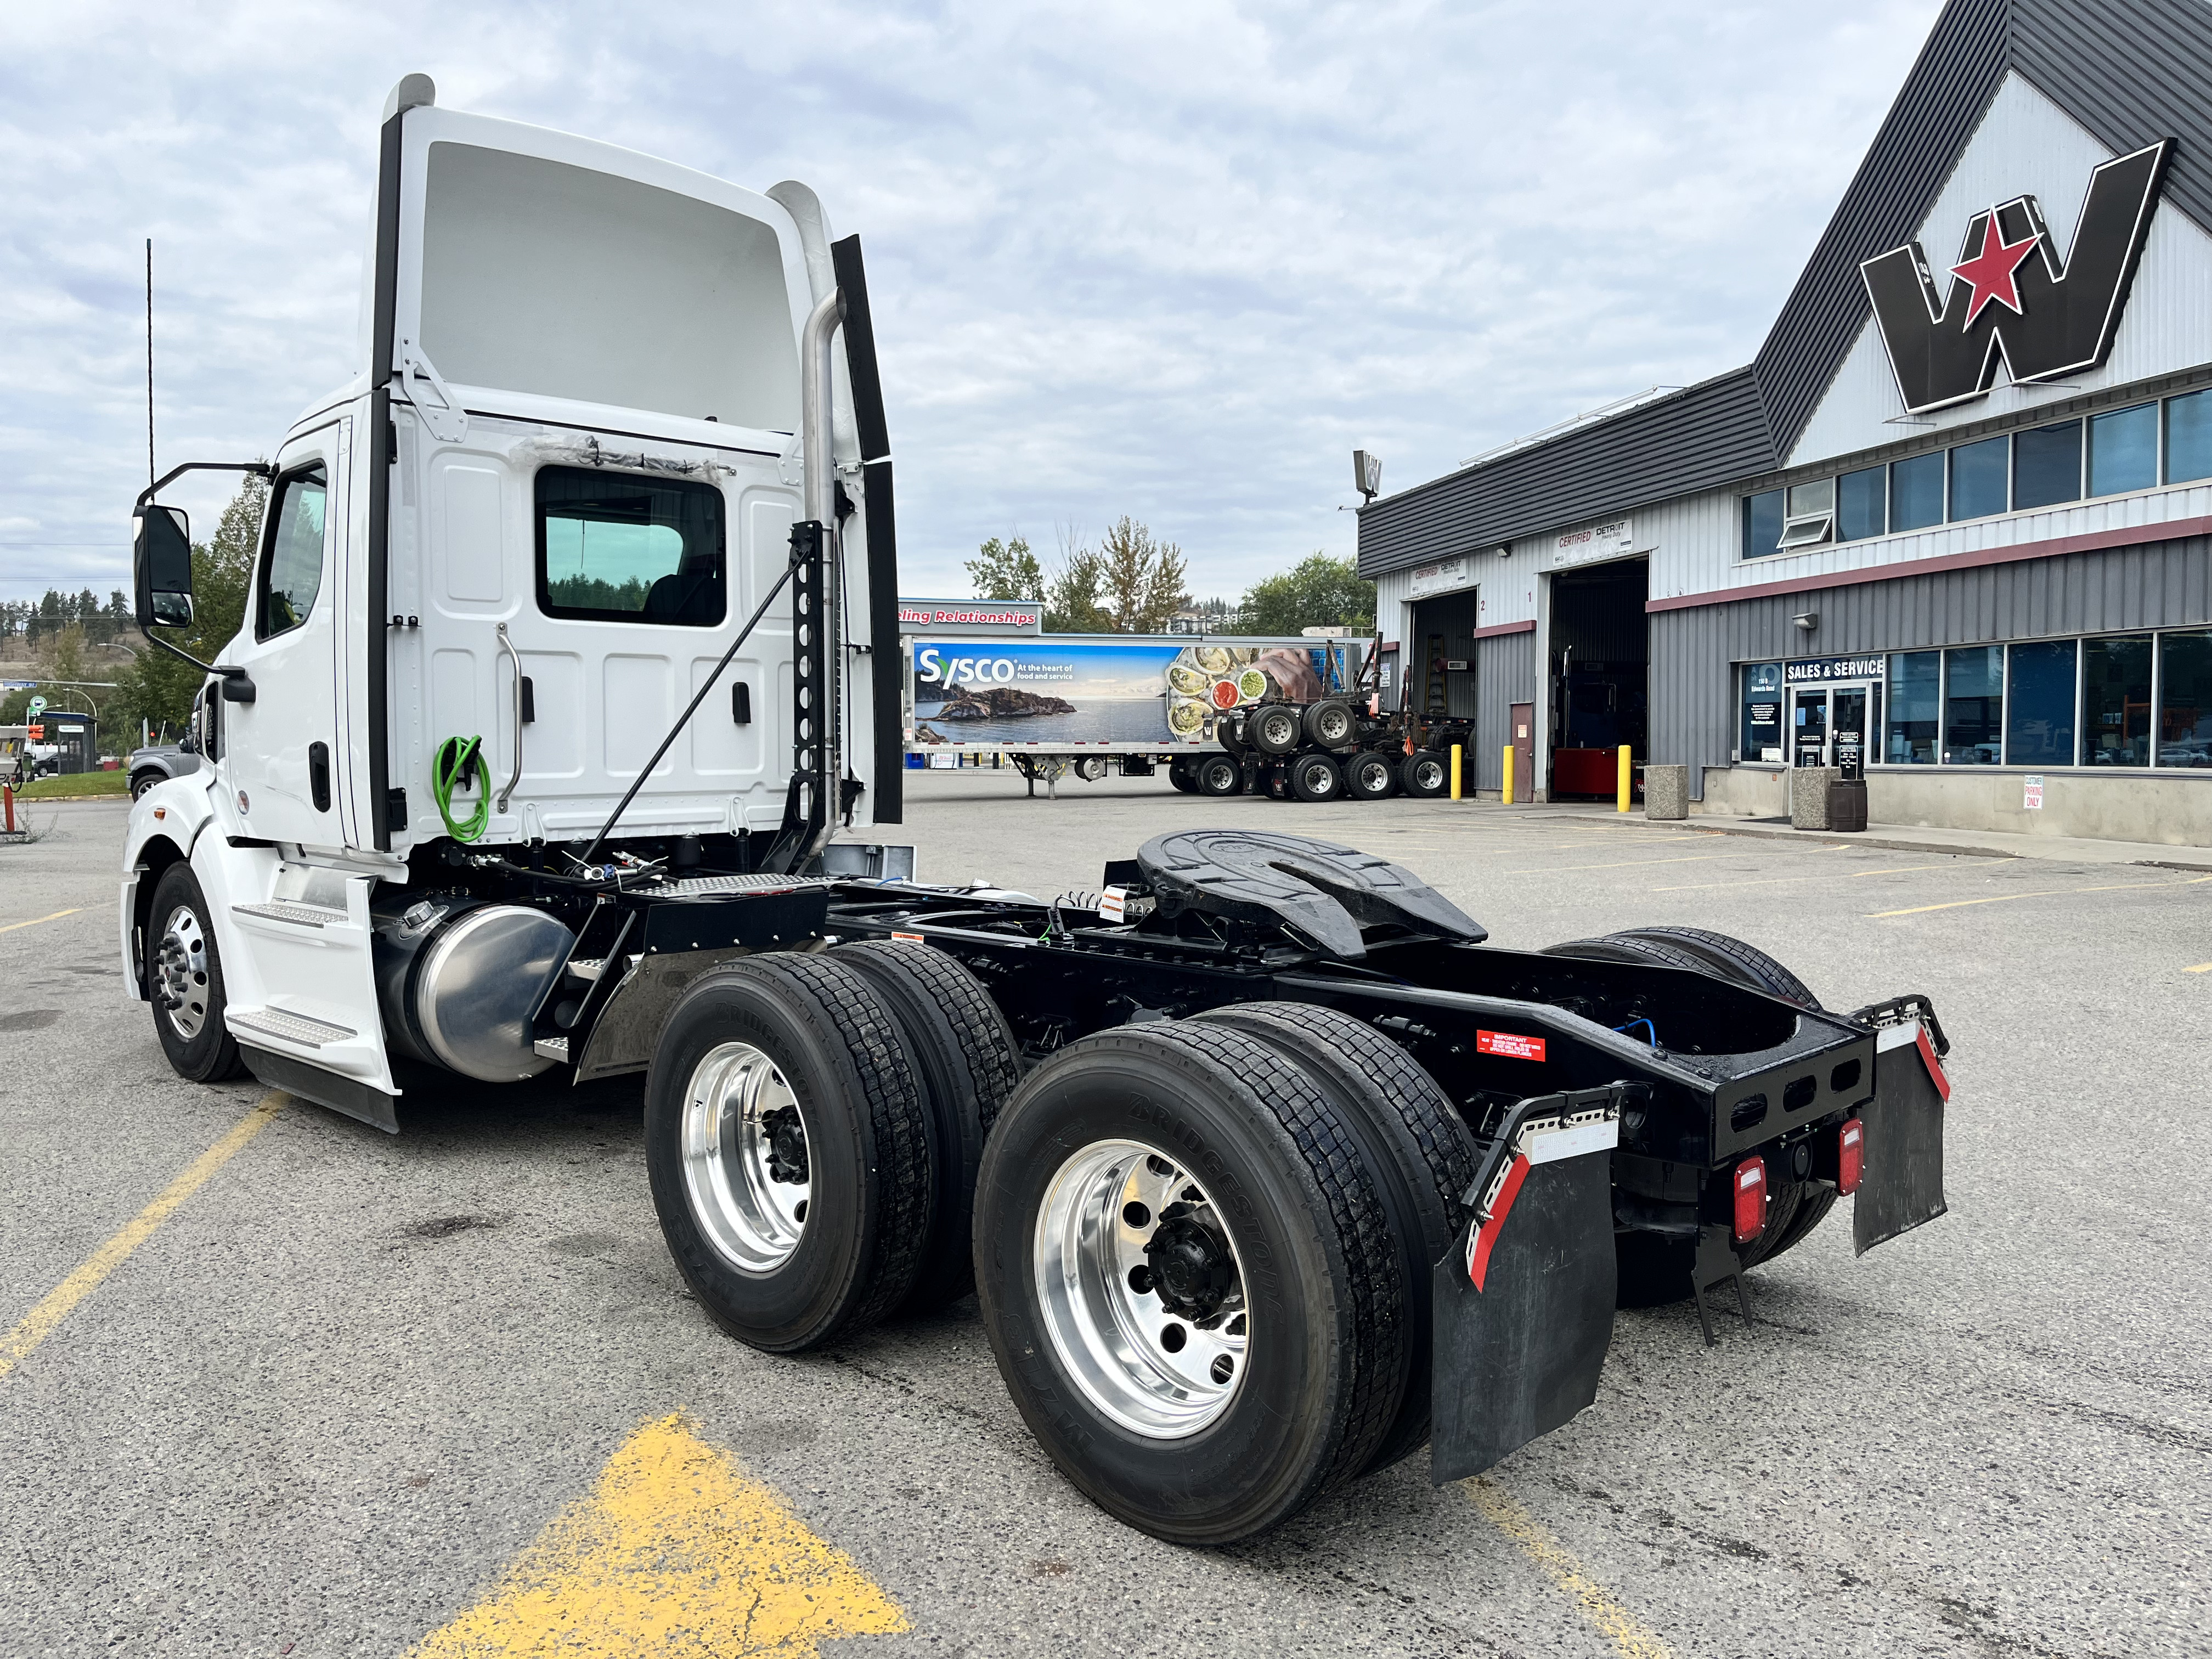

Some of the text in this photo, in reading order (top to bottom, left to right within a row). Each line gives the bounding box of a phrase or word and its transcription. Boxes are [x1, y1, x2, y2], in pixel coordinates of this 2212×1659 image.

[1559, 531, 1591, 548] CERTIFIED
[1441, 560, 1462, 571] DETRIT
[1415, 566, 1438, 579] CERTIFIED
[1528, 591, 1531, 602] 1
[1481, 600, 1485, 611] 2
[934, 610, 1036, 627] Relationships
[1787, 659, 1883, 680] SALES & SERVICE
[2025, 786, 2042, 795] PARKING
[2027, 797, 2039, 806] ONLY
[1494, 1034, 1527, 1043] IMPORTANT
[1127, 1092, 1286, 1324] BRIDGESTONE
